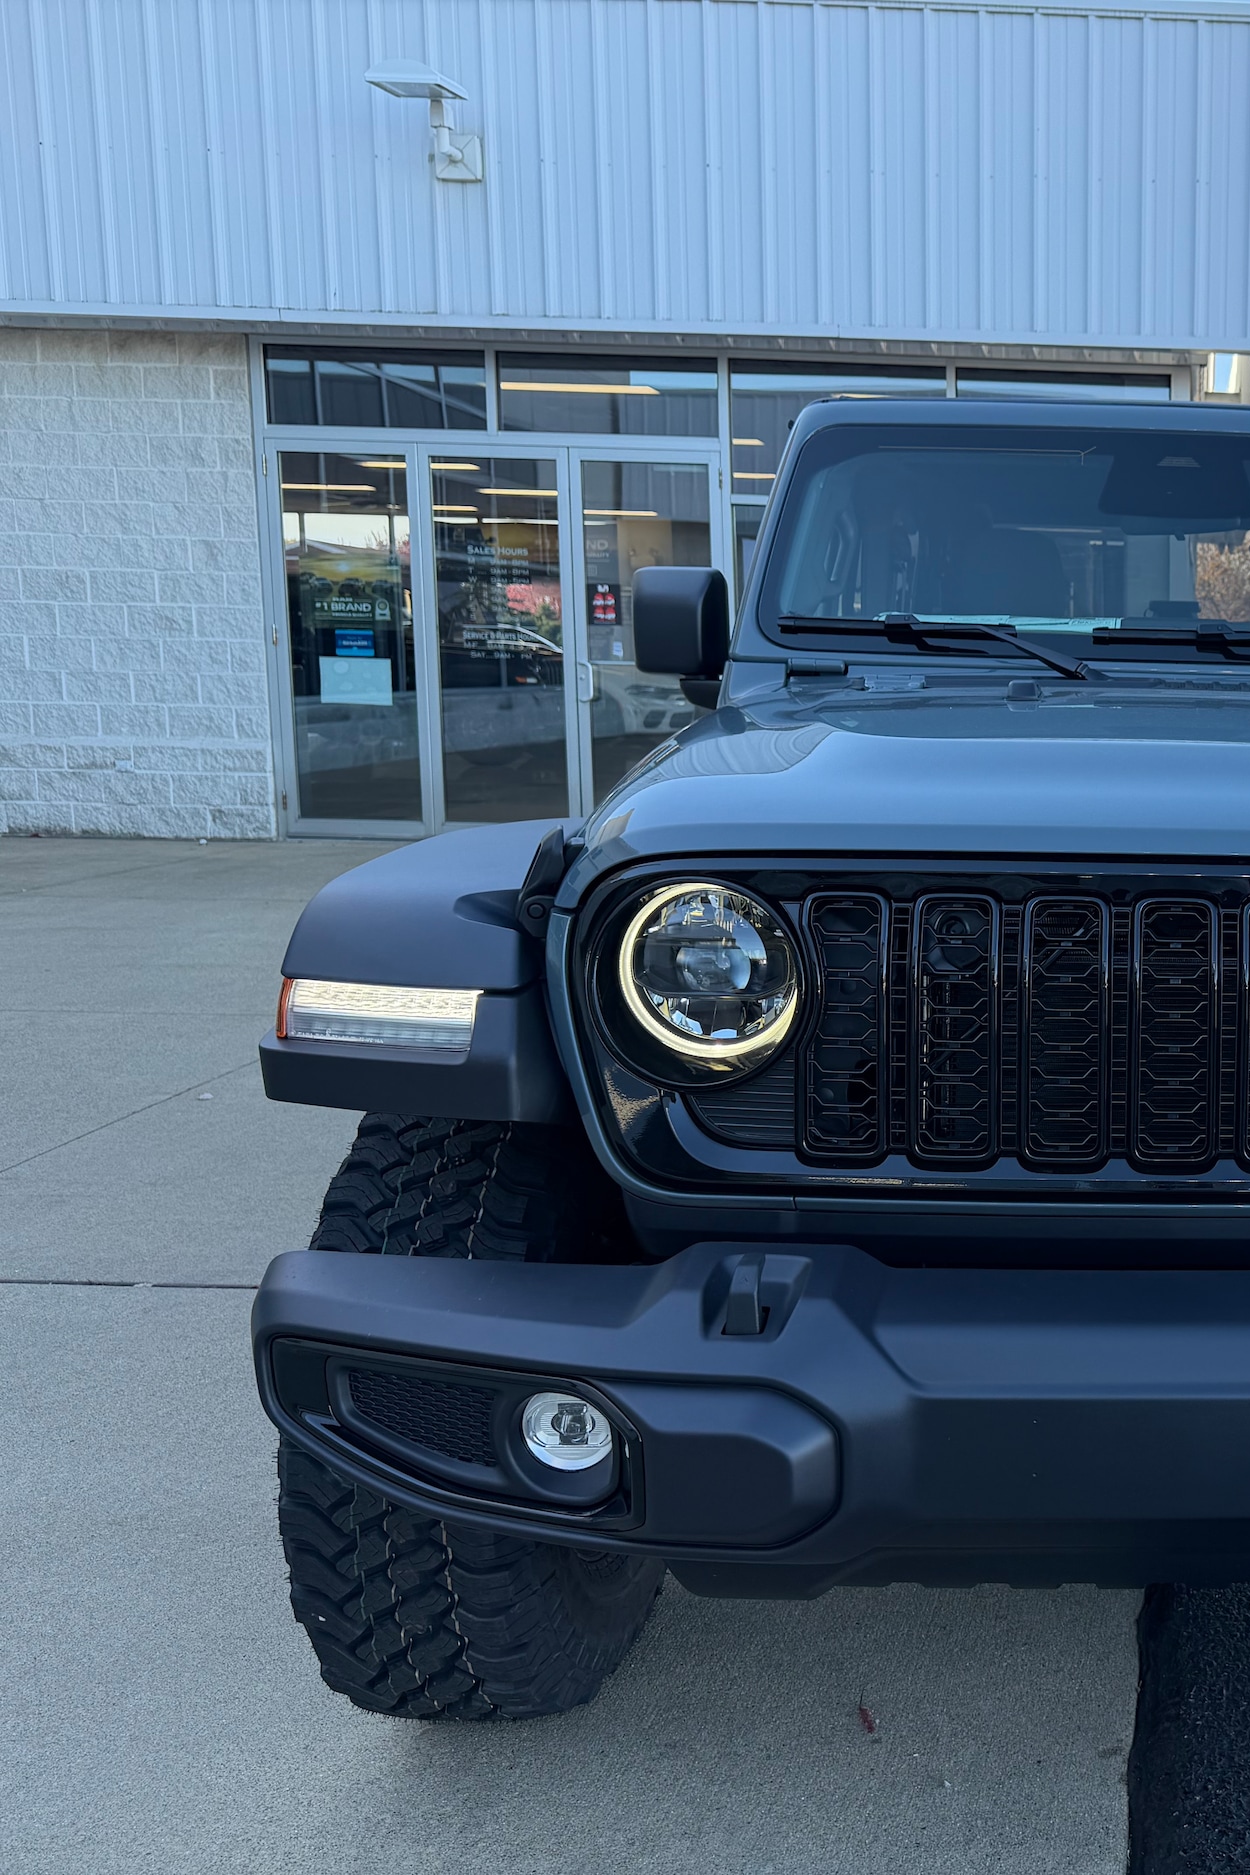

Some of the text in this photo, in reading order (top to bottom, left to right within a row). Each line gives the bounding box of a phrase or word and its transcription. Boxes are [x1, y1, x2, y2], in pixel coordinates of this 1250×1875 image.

[467, 545, 529, 556] SALES HOURS
[331, 602, 372, 612] BRAND
